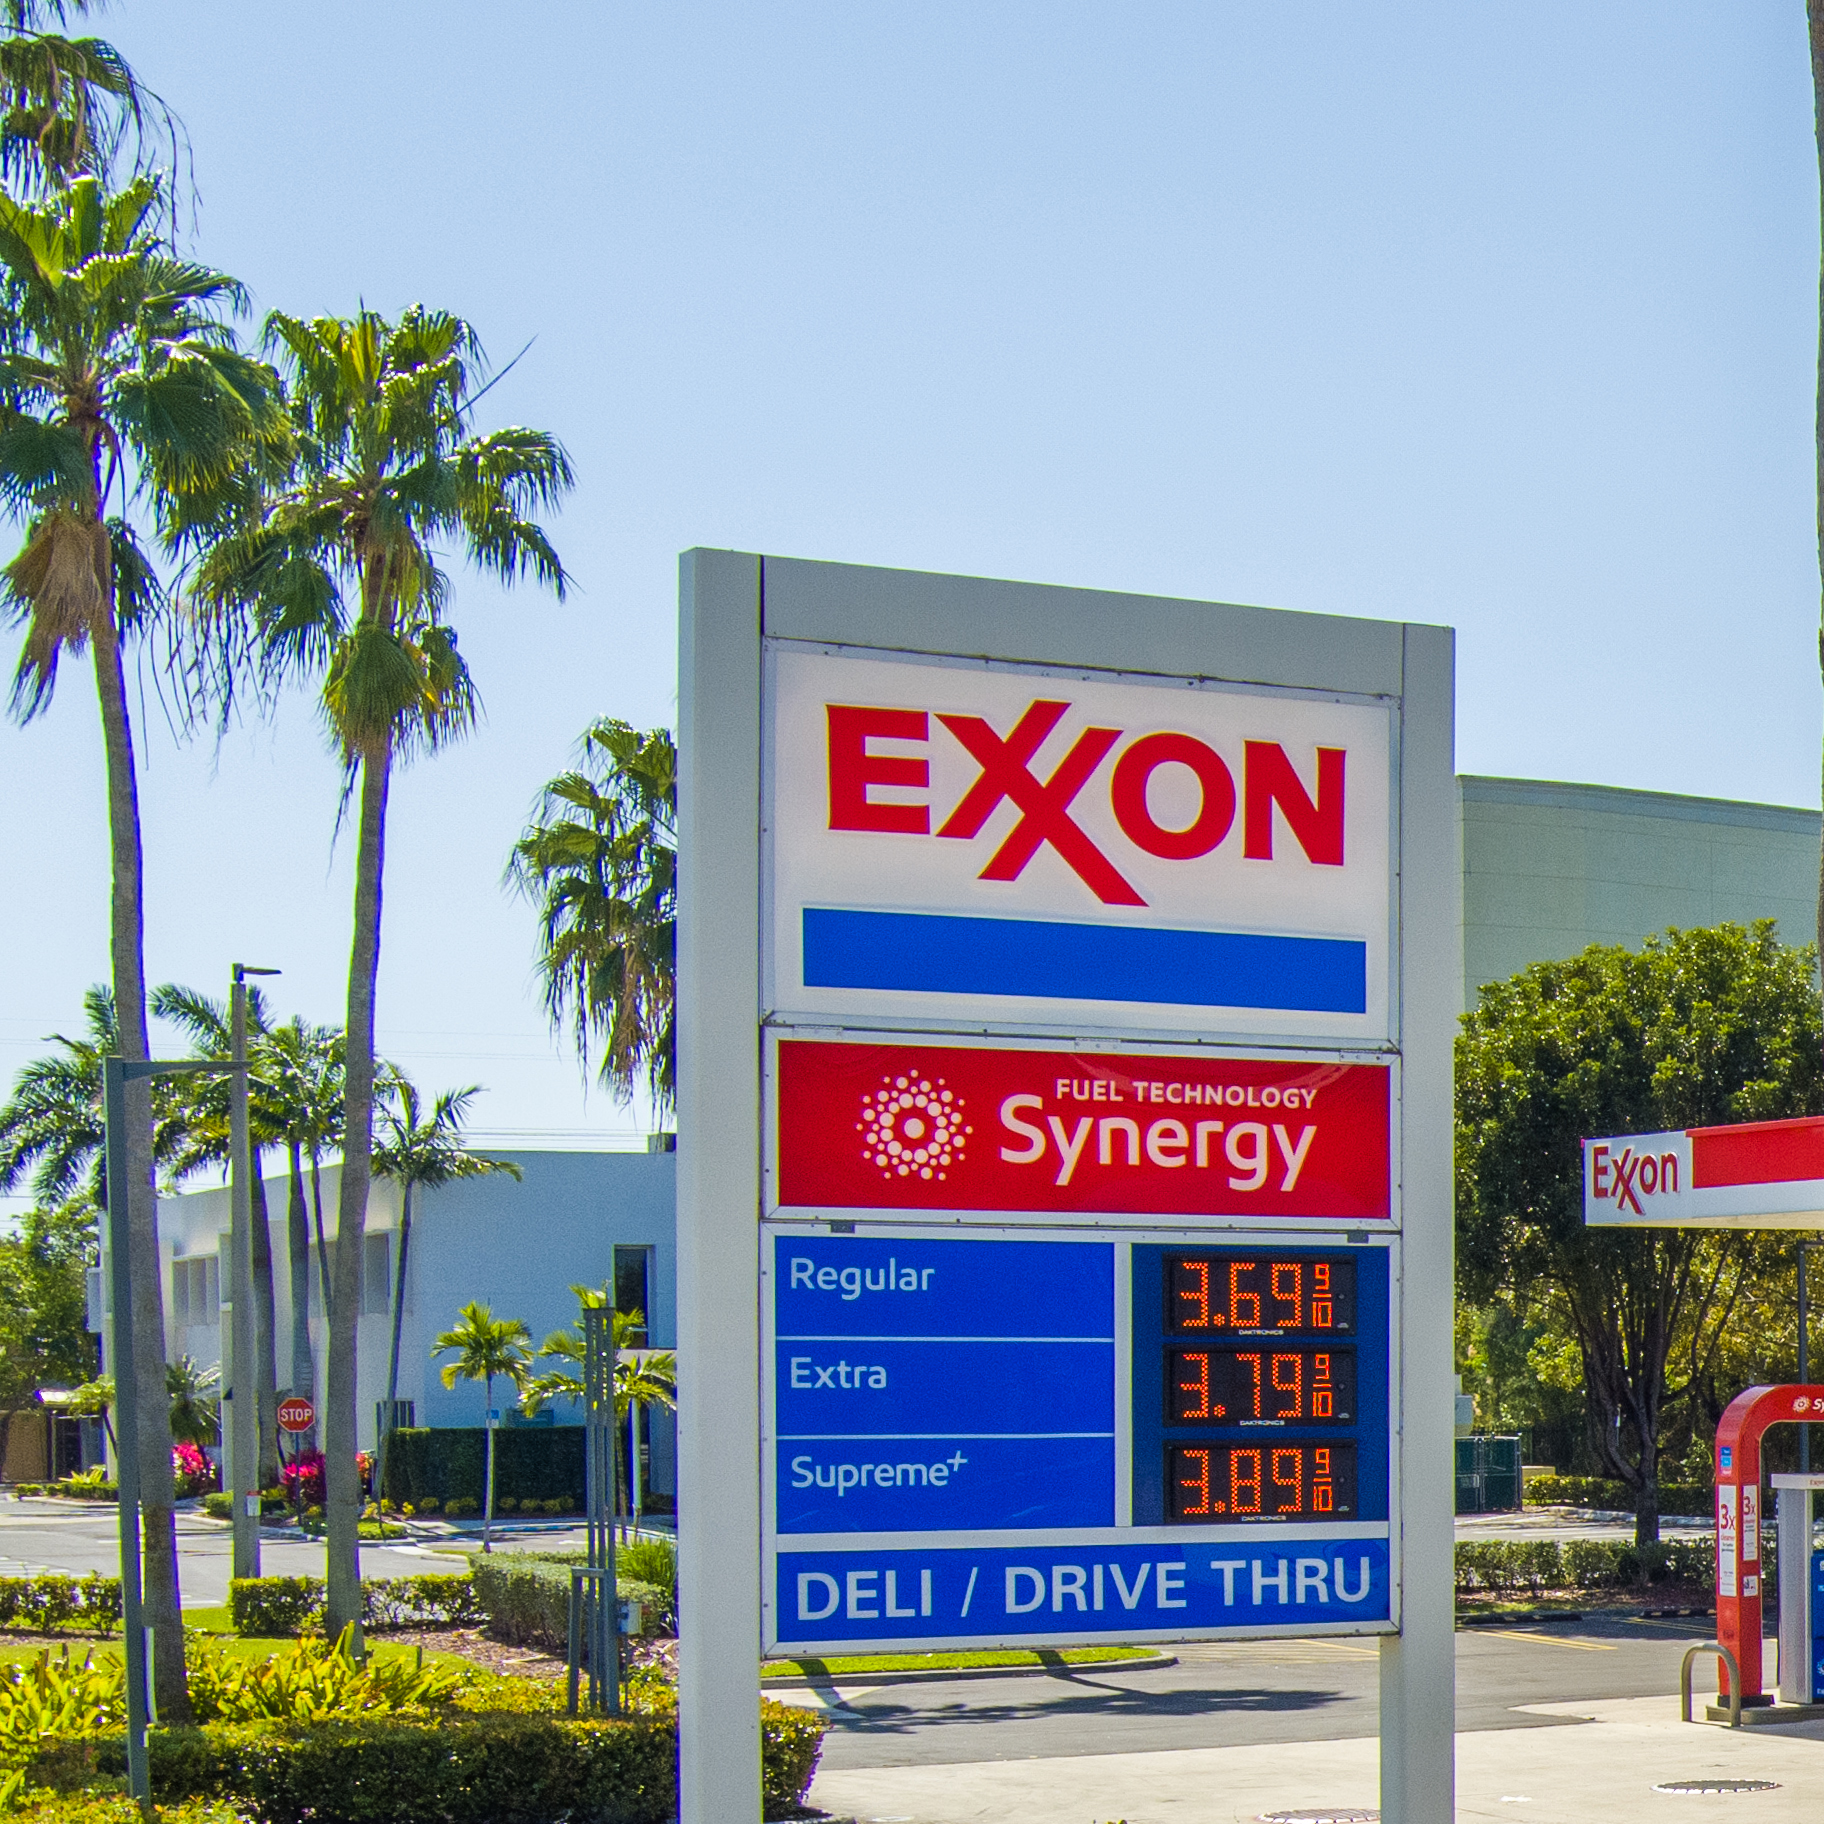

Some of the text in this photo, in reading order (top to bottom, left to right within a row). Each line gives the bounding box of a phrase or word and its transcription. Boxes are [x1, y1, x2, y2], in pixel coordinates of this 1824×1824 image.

[826, 699, 1346, 907] EXXON
[1055, 1078, 1317, 1110] FUEL TECHNOLOGY
[999, 1094, 1317, 1192] Synergy
[1592, 1145, 1680, 1215] Exxon
[790, 1257, 935, 1301] Regular
[1180, 1262, 1301, 1327] 3.69
[790, 1356, 887, 1389] Extra
[1180, 1353, 1301, 1418] 3.79
[281, 1408, 312, 1422] STOP
[1180, 1448, 1302, 1514] 3.89
[1743, 1495, 1756, 1516] 3x
[1720, 1503, 1736, 1531] 3x
[797, 1556, 1371, 1621] DELI / DRIVE THRU
